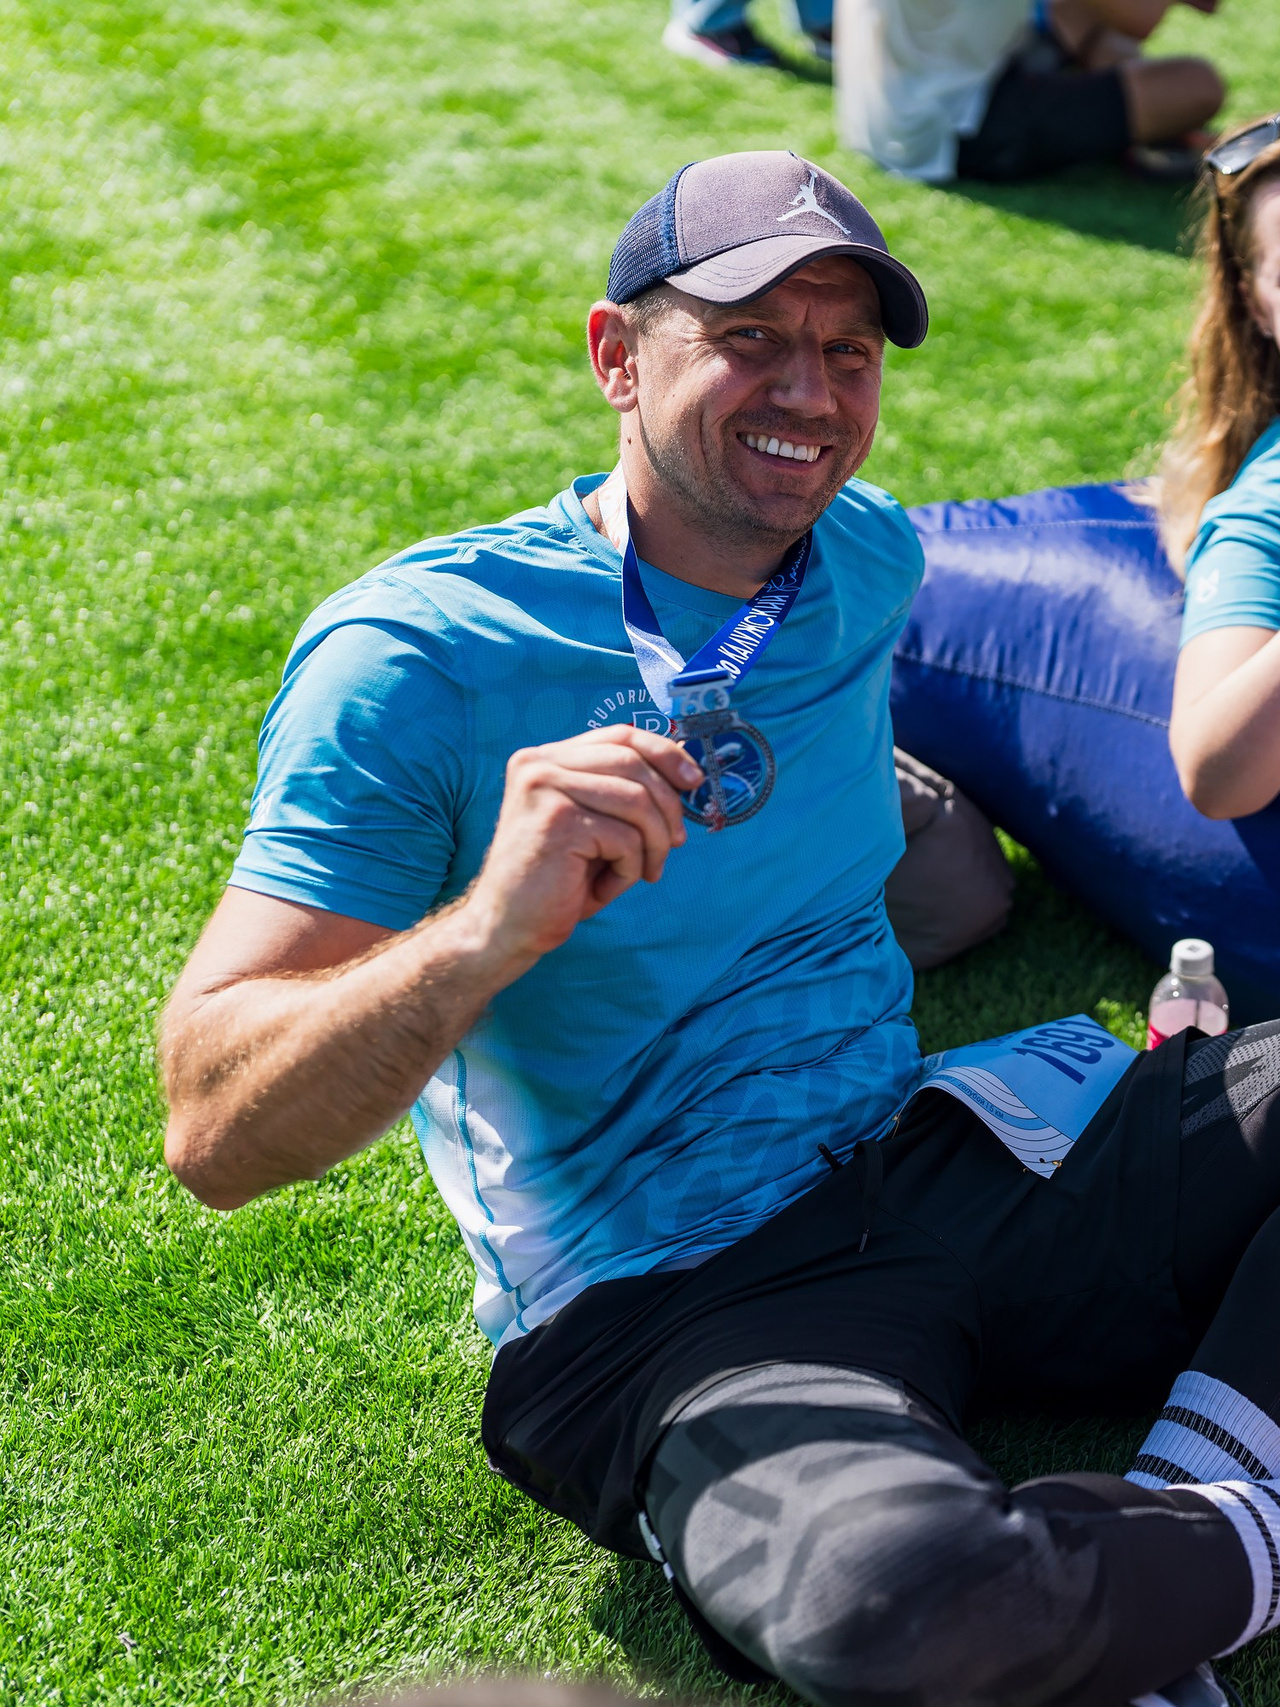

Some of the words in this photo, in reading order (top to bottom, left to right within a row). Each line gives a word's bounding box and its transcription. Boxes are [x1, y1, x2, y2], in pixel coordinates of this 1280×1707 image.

[717, 594, 789, 665] КАЛУЖСКИЙ
[586, 688, 653, 729] RUDORU
[988, 1104, 995, 1112] 5
